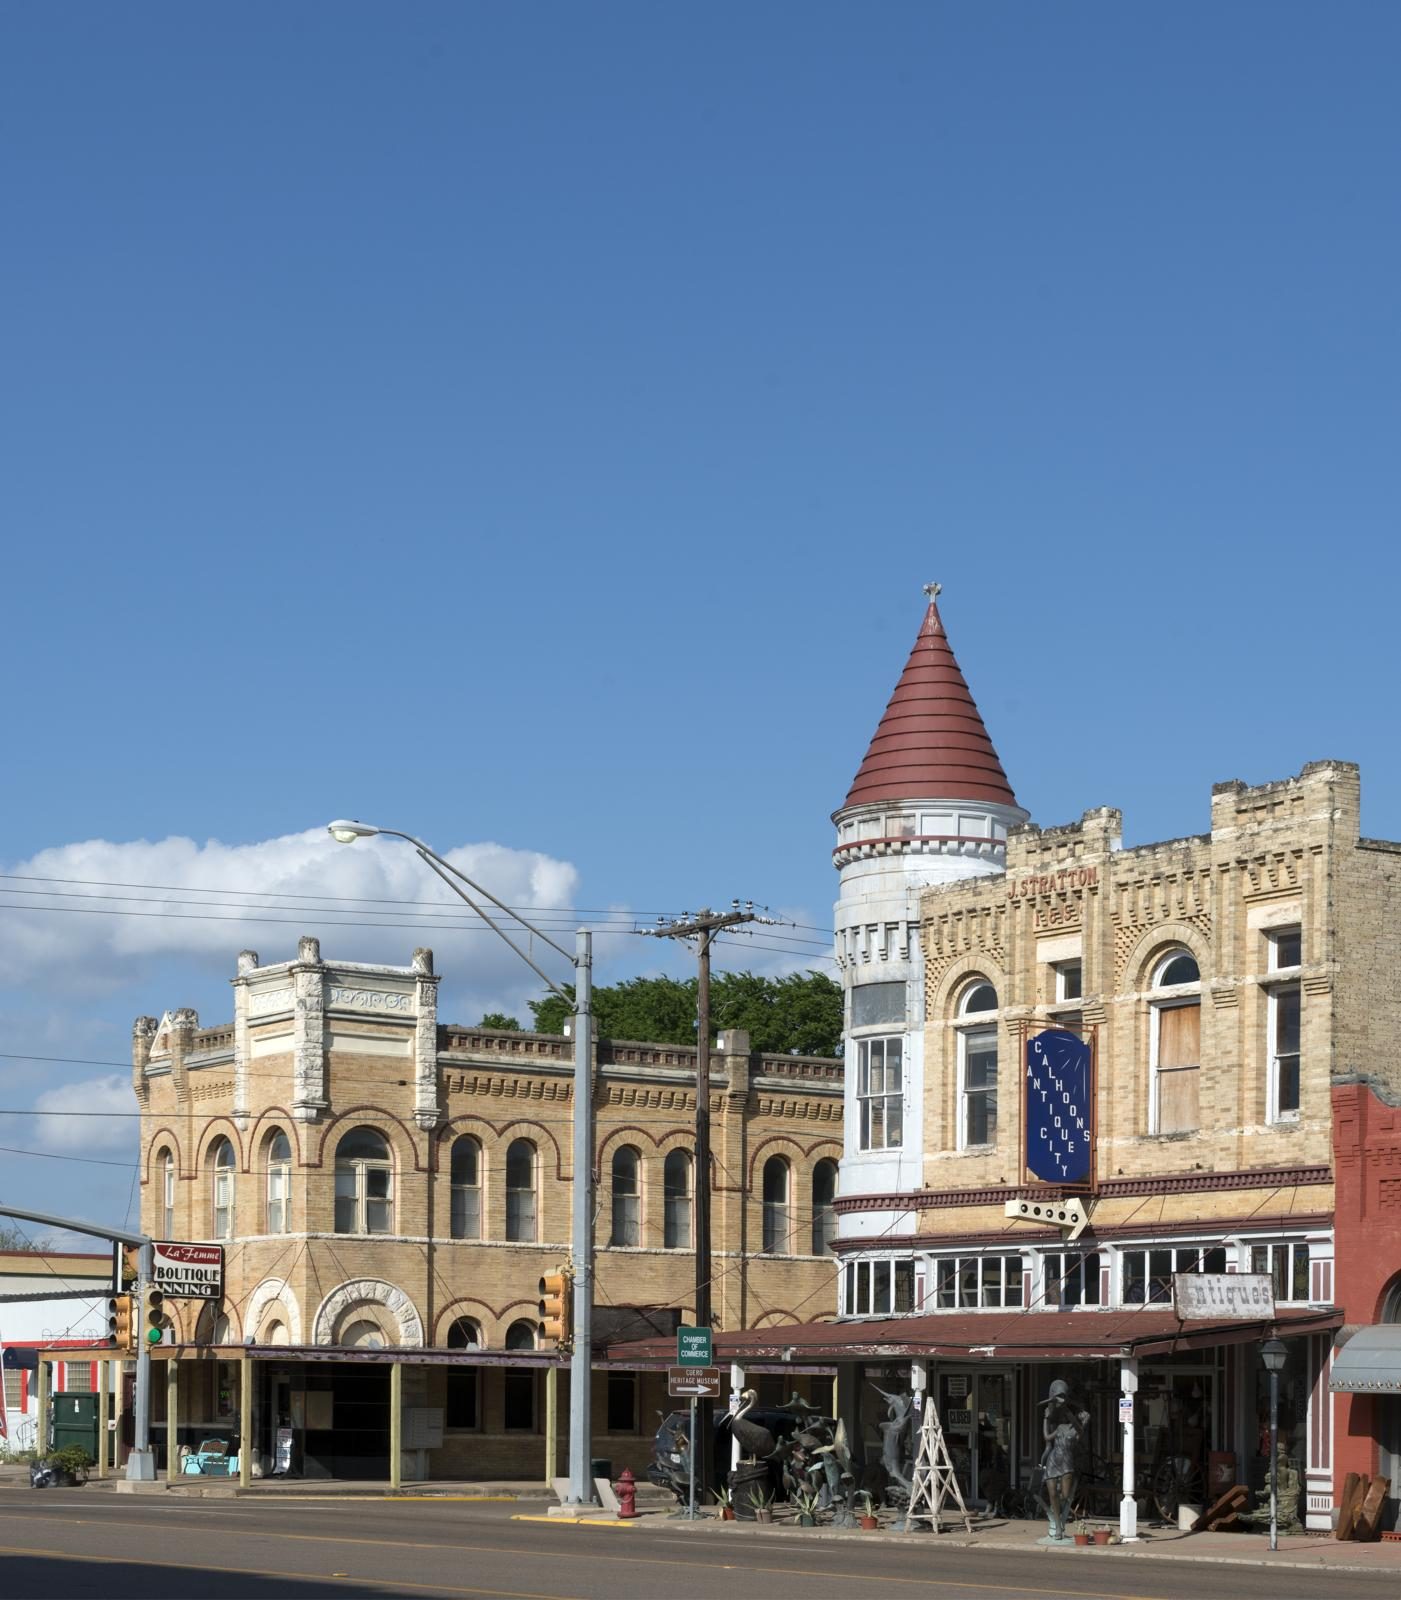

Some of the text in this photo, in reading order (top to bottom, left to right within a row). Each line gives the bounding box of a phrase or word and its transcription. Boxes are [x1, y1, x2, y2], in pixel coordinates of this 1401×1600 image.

[1034, 1041, 1090, 1142] CALHOONS
[1026, 1065, 1074, 1153] ANTIQUE
[1040, 1127, 1068, 1176] CITY
[165, 1245, 220, 1261] La Femme
[157, 1266, 219, 1282] BOUTIQUE
[682, 1335, 707, 1344] CHAMBER
[690, 1343, 699, 1351] OF
[680, 1350, 709, 1358] COMMERCE
[696, 1377, 719, 1385] MUSEUM
